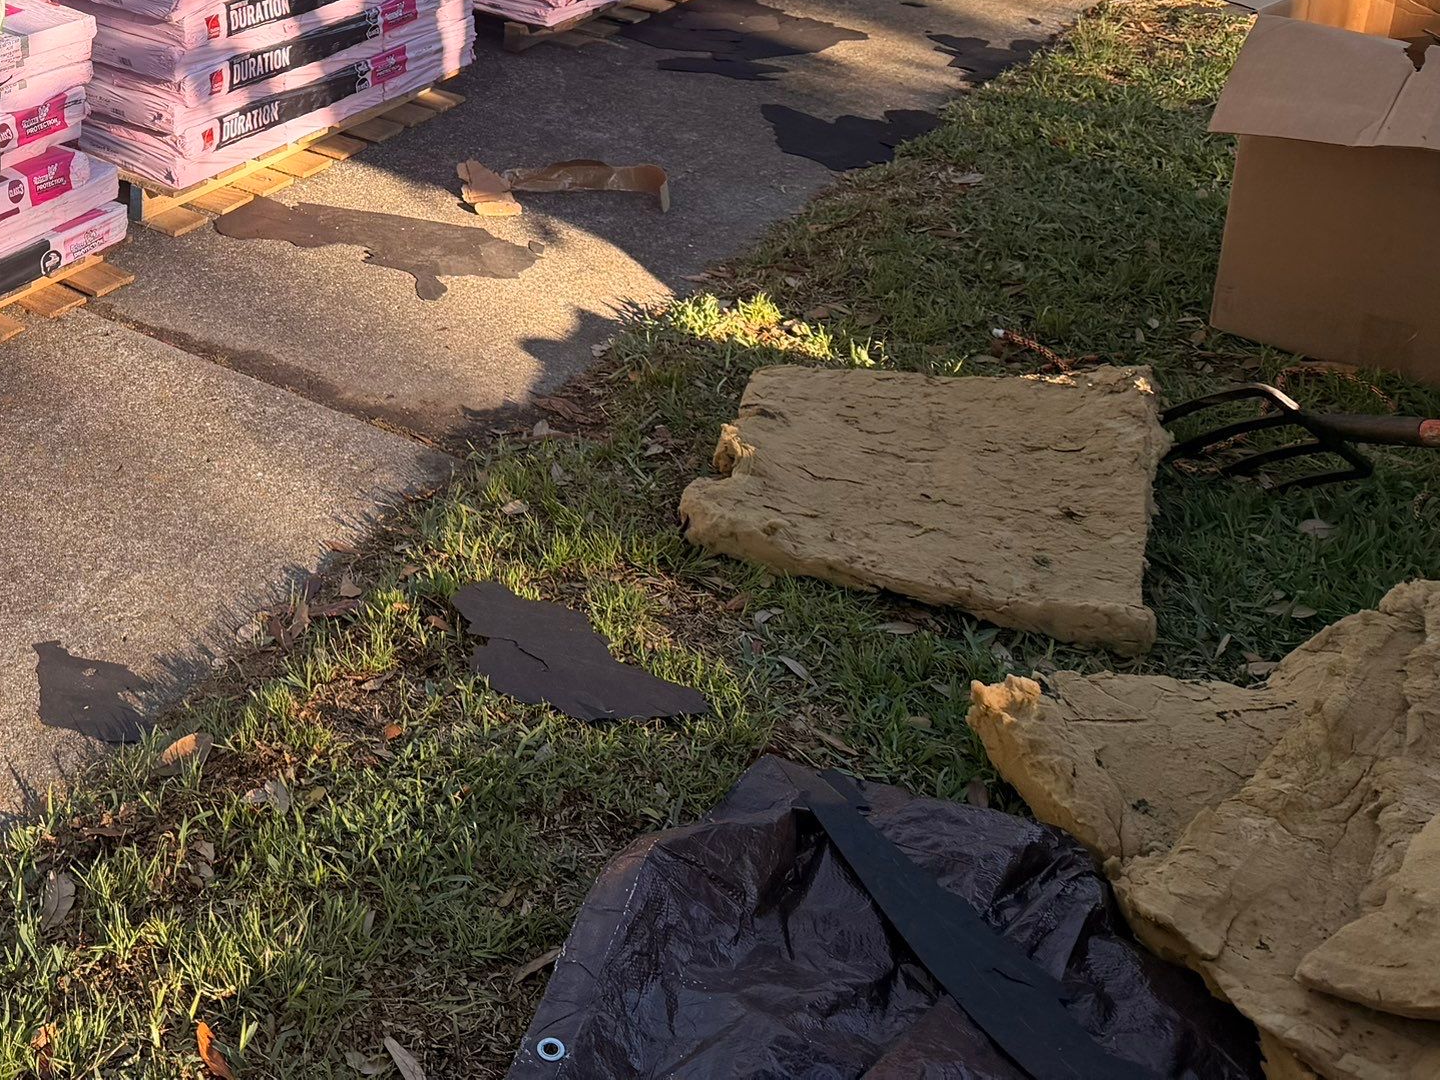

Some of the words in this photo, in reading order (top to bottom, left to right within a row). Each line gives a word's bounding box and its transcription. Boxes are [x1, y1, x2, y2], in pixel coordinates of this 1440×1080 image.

[232, 45, 292, 77] DURATION
[26, 117, 59, 136] PROTECTION
[222, 101, 281, 134] DURATION
[36, 176, 65, 192] PROTECTION
